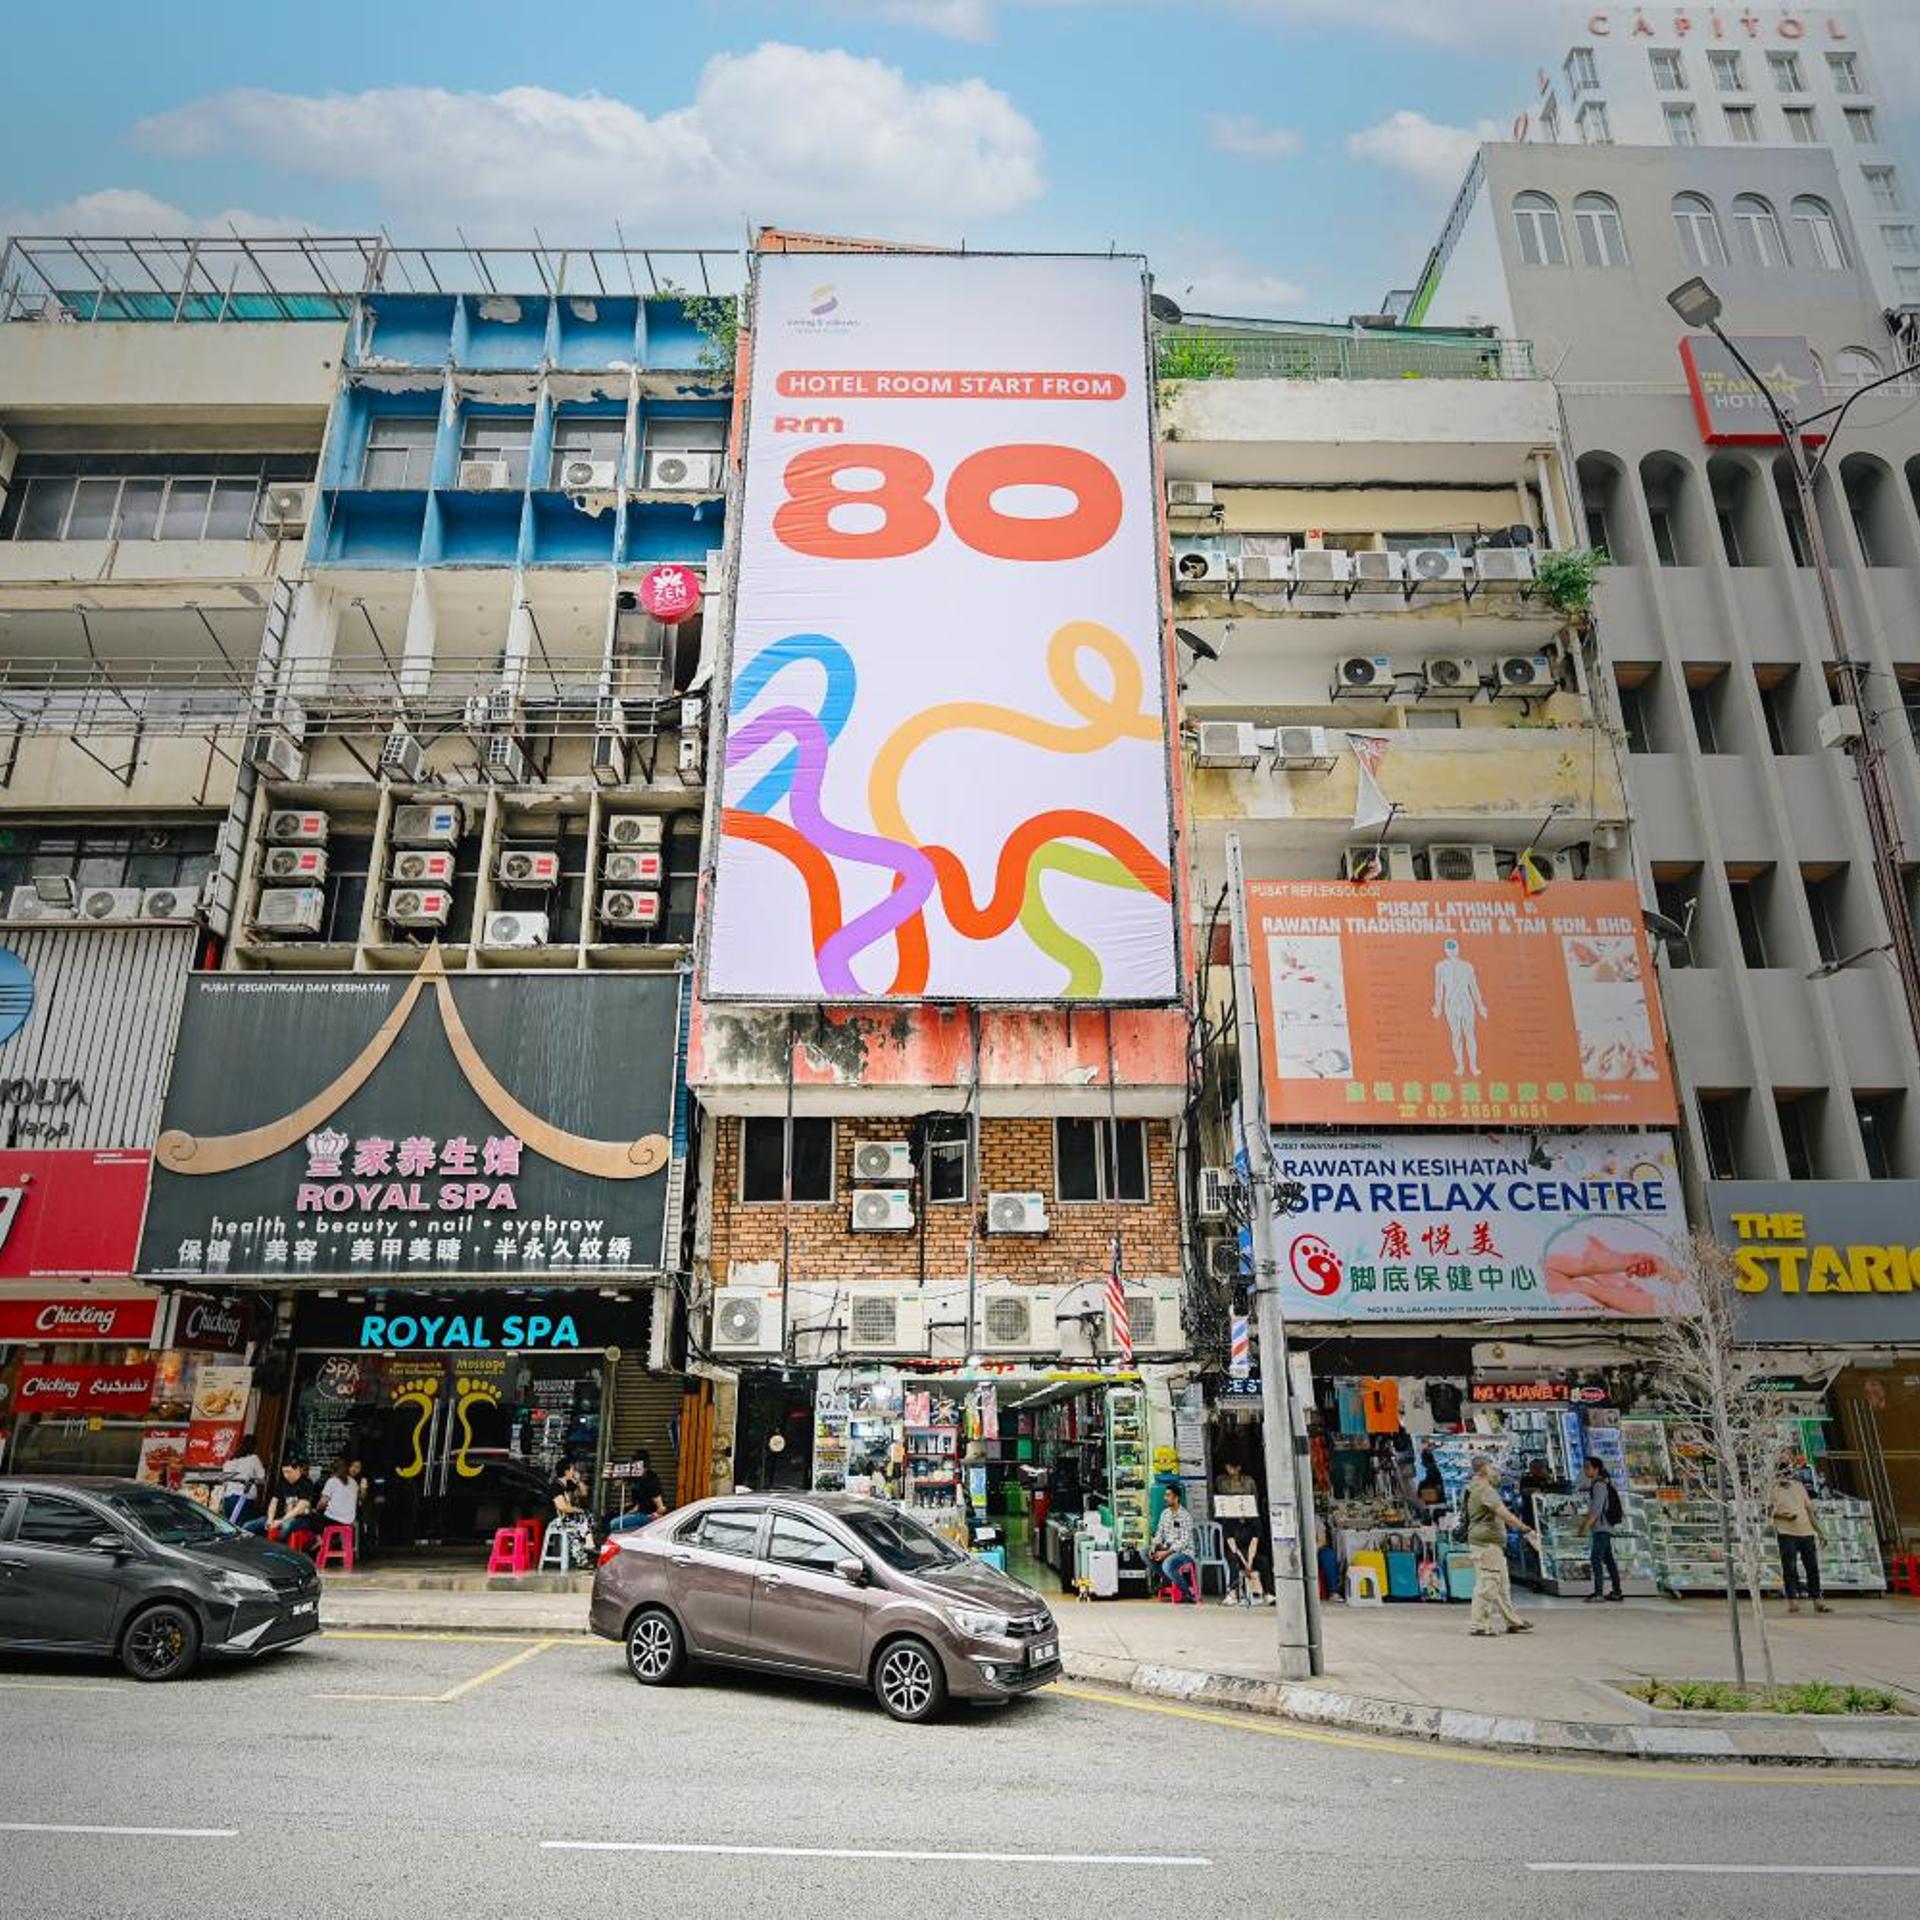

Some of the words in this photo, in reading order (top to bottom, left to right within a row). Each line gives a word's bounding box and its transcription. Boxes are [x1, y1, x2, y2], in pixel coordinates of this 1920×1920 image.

[1587, 15, 1847, 40] CAPITOL
[790, 376, 868, 393] HOTEL
[877, 376, 952, 394] ROOM
[960, 377, 1032, 394] START
[1042, 378, 1113, 395] FROM
[772, 443, 1123, 562] 80
[654, 585, 687, 600] ZEN
[1376, 901, 1429, 917] PUSAT
[1262, 916, 1341, 934] RAWATAN
[1345, 916, 1456, 934] TRADISIONAL
[200, 983, 235, 993] PUSAT
[305, 983, 329, 993] DAN
[331, 983, 390, 993] KESIHATAN
[1284, 1158, 1397, 1177] RAWATAN
[1402, 1158, 1529, 1176] KESIHATAN
[296, 1183, 431, 1212] ROYAL
[437, 1183, 518, 1211] SPA
[1370, 1182, 1503, 1212] RELAX
[1508, 1181, 1667, 1212] CENTRE
[211, 1216, 286, 1234] health
[315, 1216, 398, 1237] beauty
[427, 1215, 472, 1233] nail
[501, 1214, 604, 1238] eyebrow
[1731, 1213, 1806, 1239] THE
[1378, 1220, 1503, 1260] 康悦美
[1350, 1263, 1538, 1293] 脚底保健中心
[35, 1304, 117, 1333] Chicking
[186, 1302, 241, 1348] Chicking
[360, 1316, 491, 1347] ROYAL
[501, 1316, 579, 1347] SPA
[326, 1356, 360, 1381] SPA
[22, 1377, 80, 1397] Chicking
